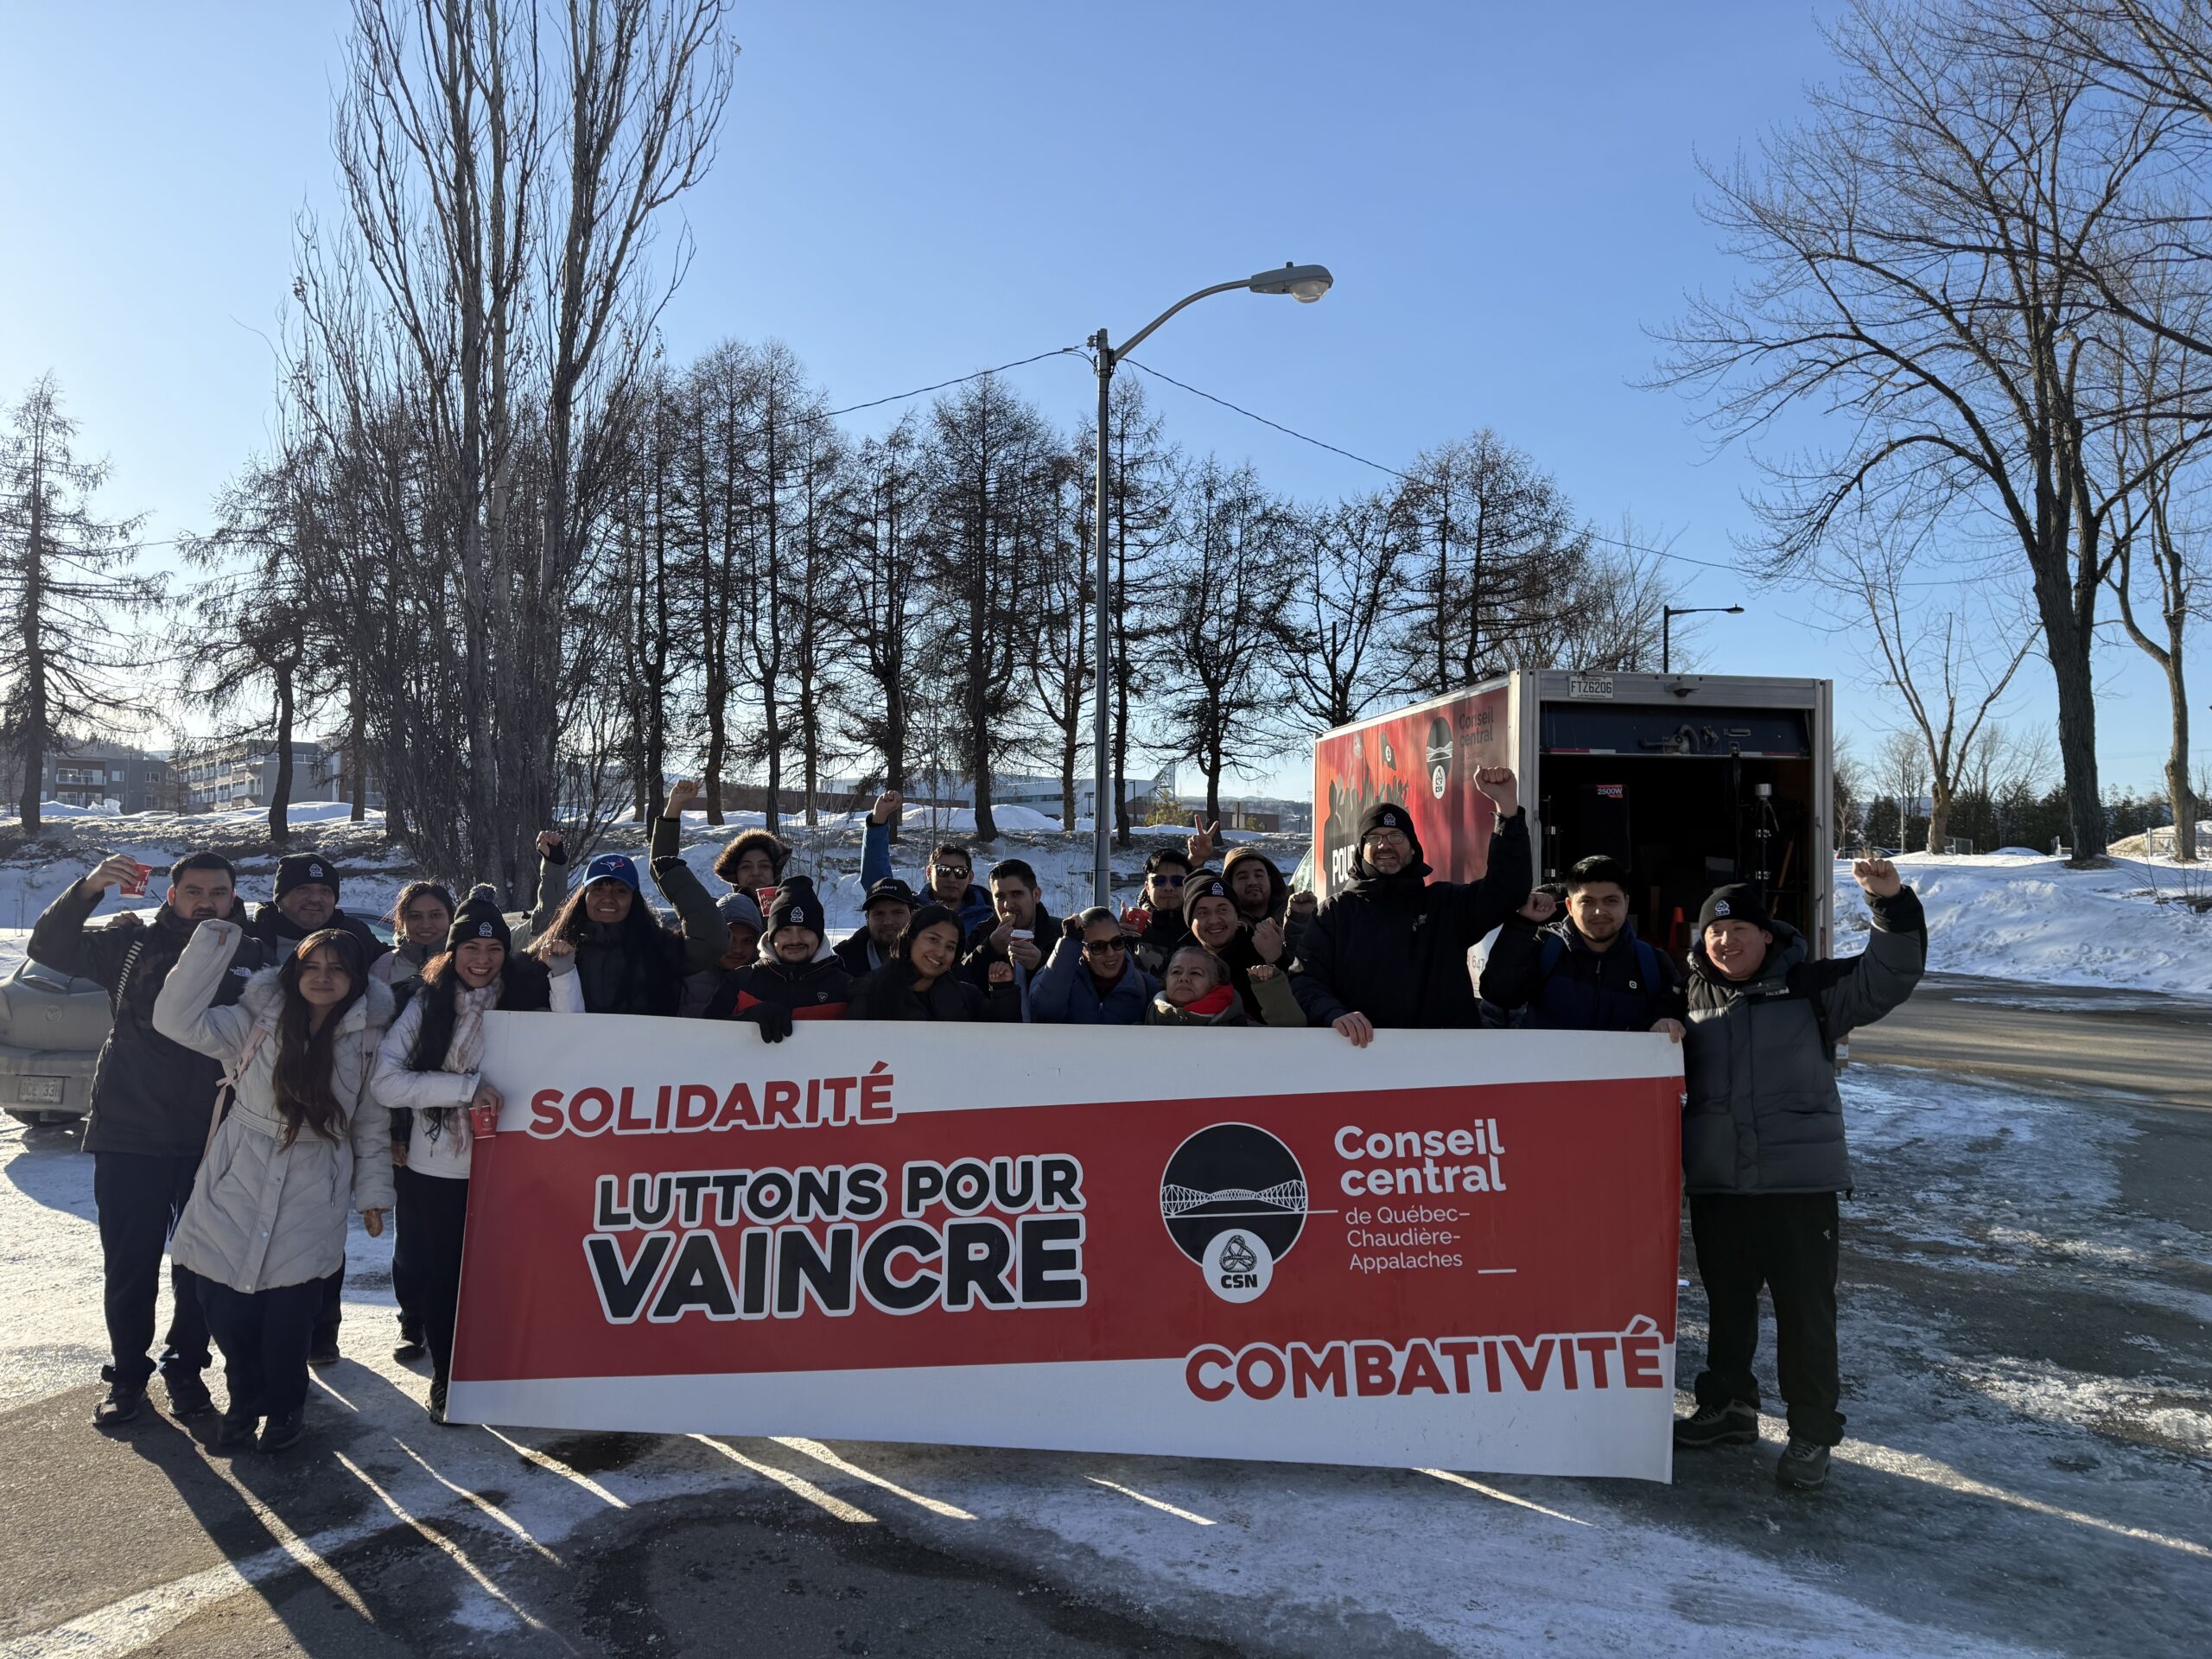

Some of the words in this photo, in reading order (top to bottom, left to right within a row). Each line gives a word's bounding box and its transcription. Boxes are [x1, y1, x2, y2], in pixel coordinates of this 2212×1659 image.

[1571, 681, 1612, 694] FTZ6206
[1459, 705, 1494, 730] Conseil
[1459, 725, 1494, 747] central
[529, 1060, 894, 1137] SOLIDARITÉ
[1334, 1118, 1506, 1160] Conseil
[1340, 1154, 1507, 1196] central
[596, 1166, 885, 1227] LUTTONS
[906, 1158, 1082, 1213] POUR
[1345, 1207, 1371, 1224] de
[1347, 1228, 1461, 1247] Chaudière-
[587, 1217, 1083, 1319] VAINCRE
[1350, 1251, 1463, 1274] Appalaches
[1221, 1274, 1258, 1288] CSN
[1185, 1317, 1664, 1402] COMBATIVITÉ
